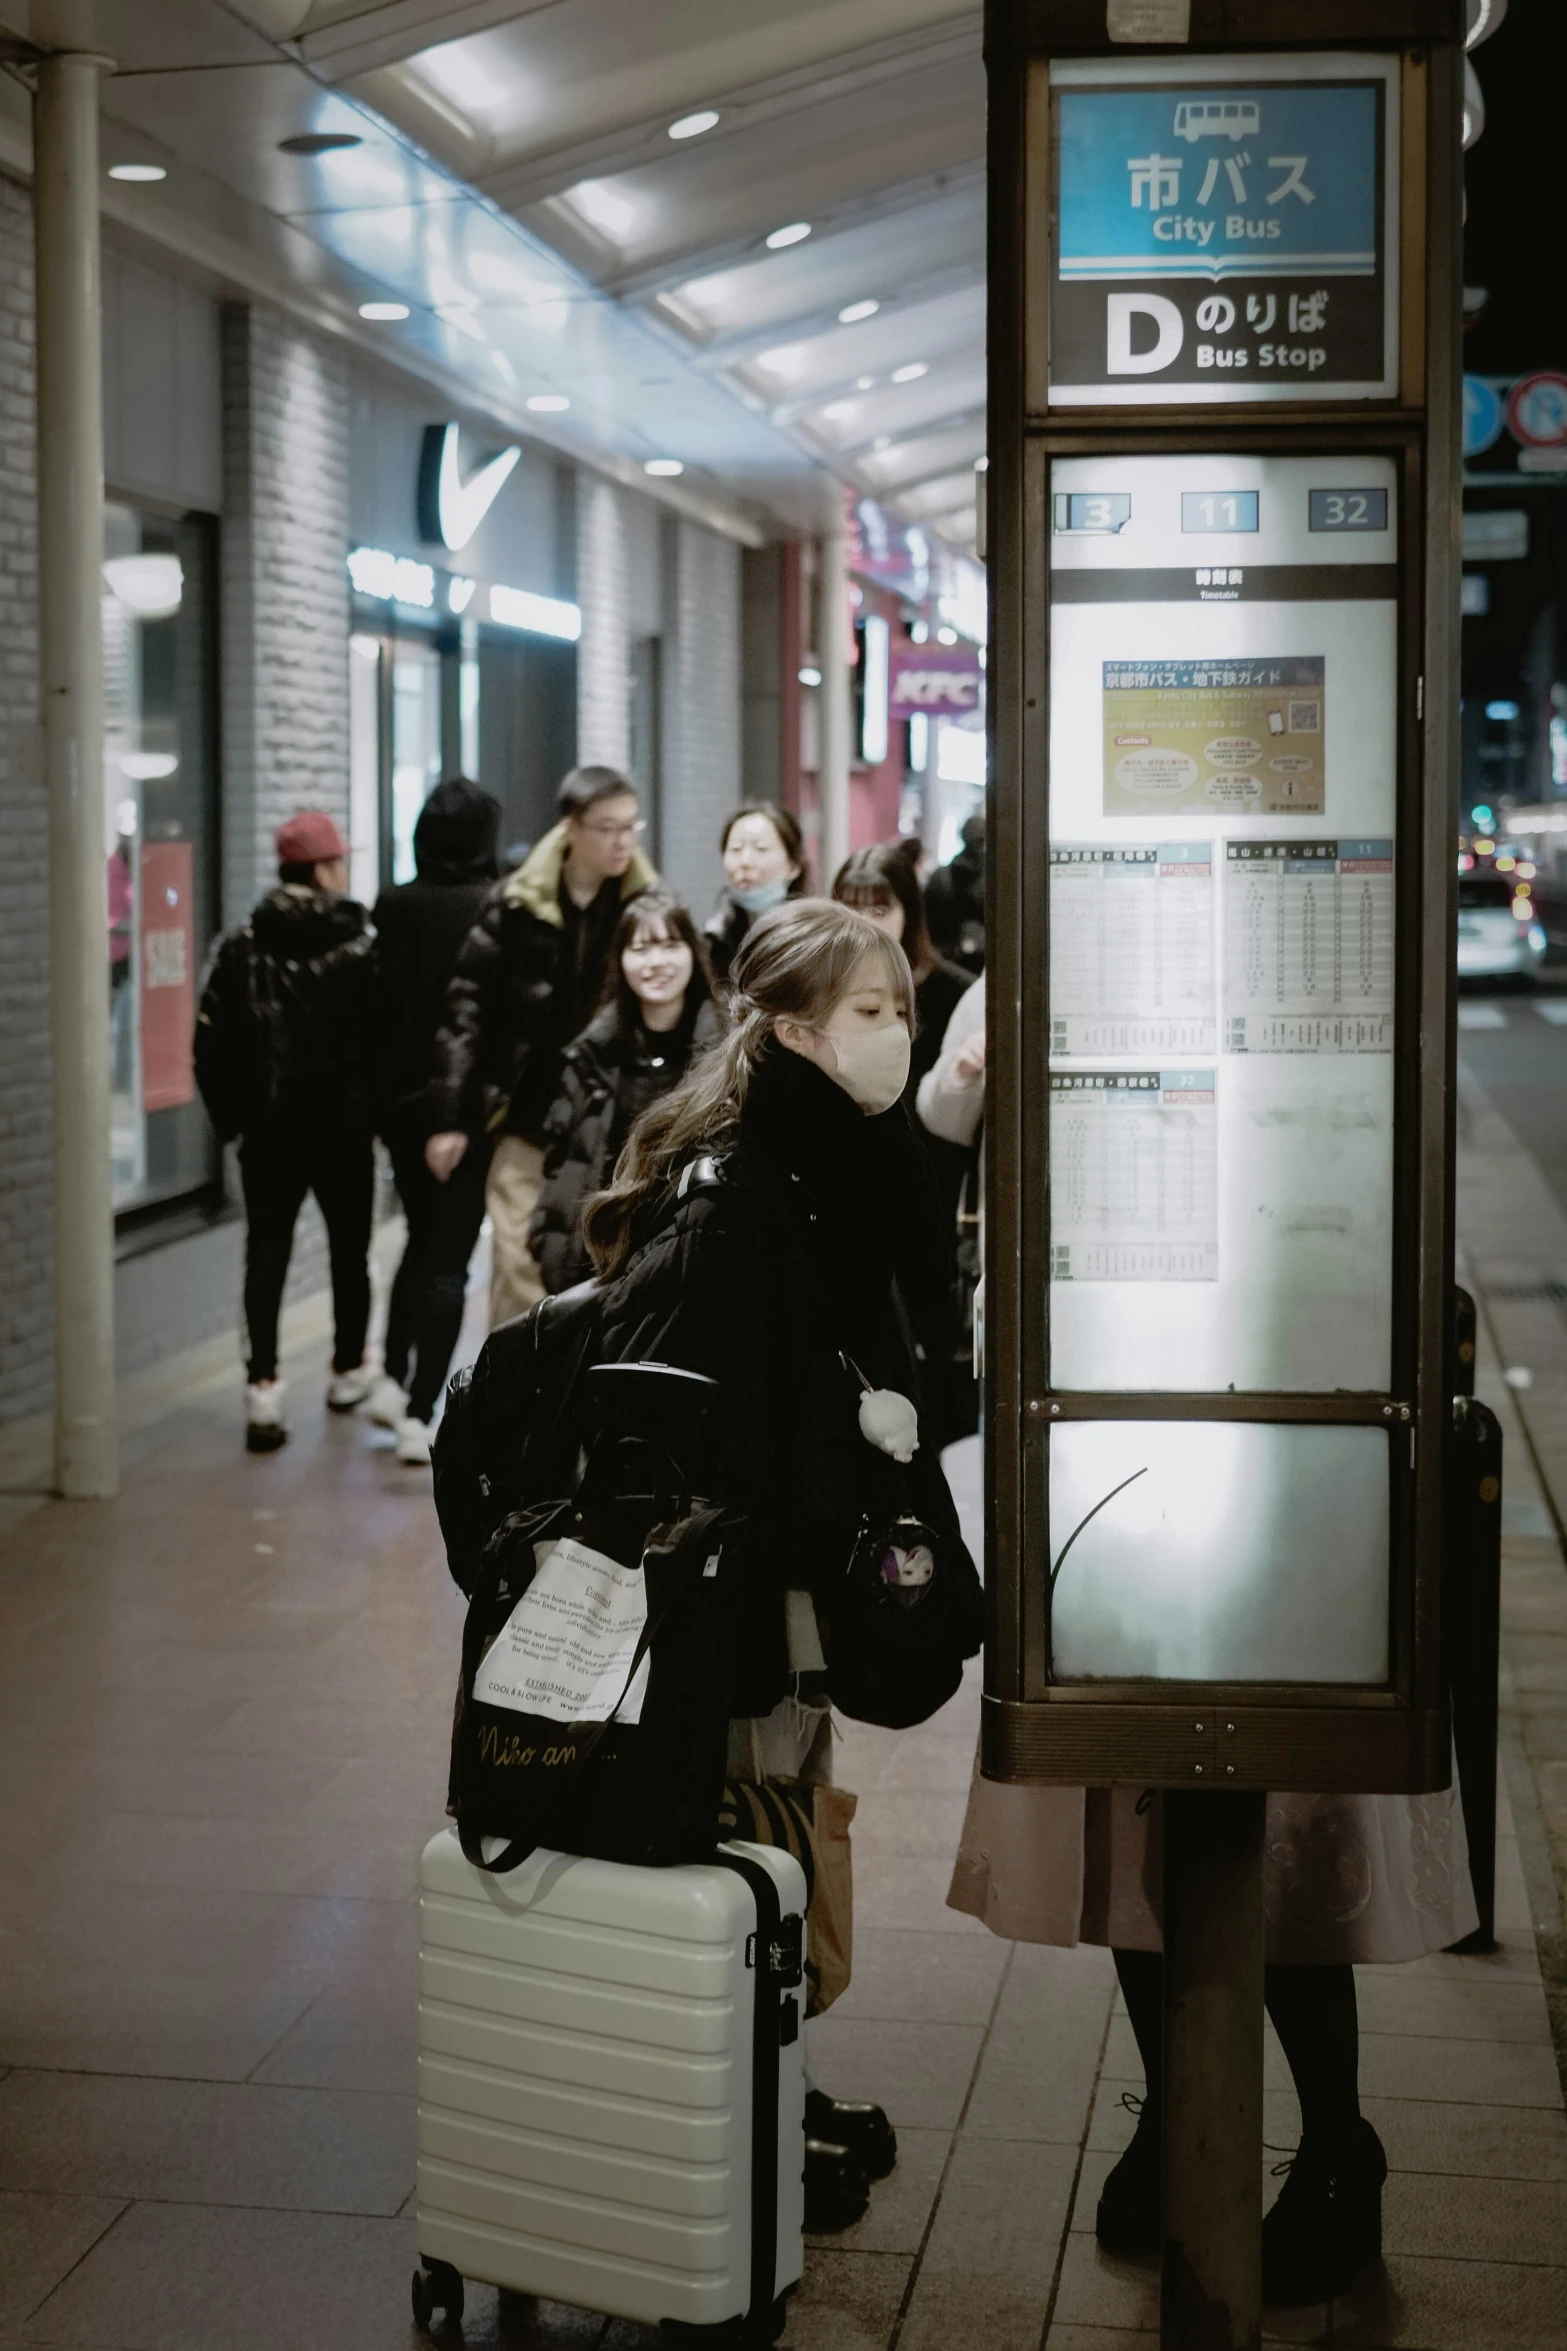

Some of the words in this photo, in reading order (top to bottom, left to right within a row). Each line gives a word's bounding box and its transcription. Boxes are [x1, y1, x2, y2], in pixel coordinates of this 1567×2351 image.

[1126, 151, 1317, 212] 市バス
[1152, 215, 1215, 247] City
[1225, 215, 1281, 240] Bus
[1195, 290, 1330, 335] のりば
[1106, 292, 1184, 375] D
[1196, 346, 1247, 369] Bus
[1258, 344, 1327, 372] Stop
[1084, 498, 1112, 528] 3
[1197, 497, 1238, 528] 11
[1324, 495, 1370, 525] 32
[1195, 568, 1244, 586] 時刻表
[1199, 590, 1240, 600] Timetable
[541, 1599, 558, 1612] lives
[558, 1605, 571, 1616] and
[551, 1592, 567, 1606] born
[511, 1644, 522, 1654] for
[522, 1647, 541, 1662] being
[530, 1638, 544, 1650] and
[584, 1657, 598, 1668] and
[533, 1629, 548, 1641] and
[580, 1644, 593, 1657] and
